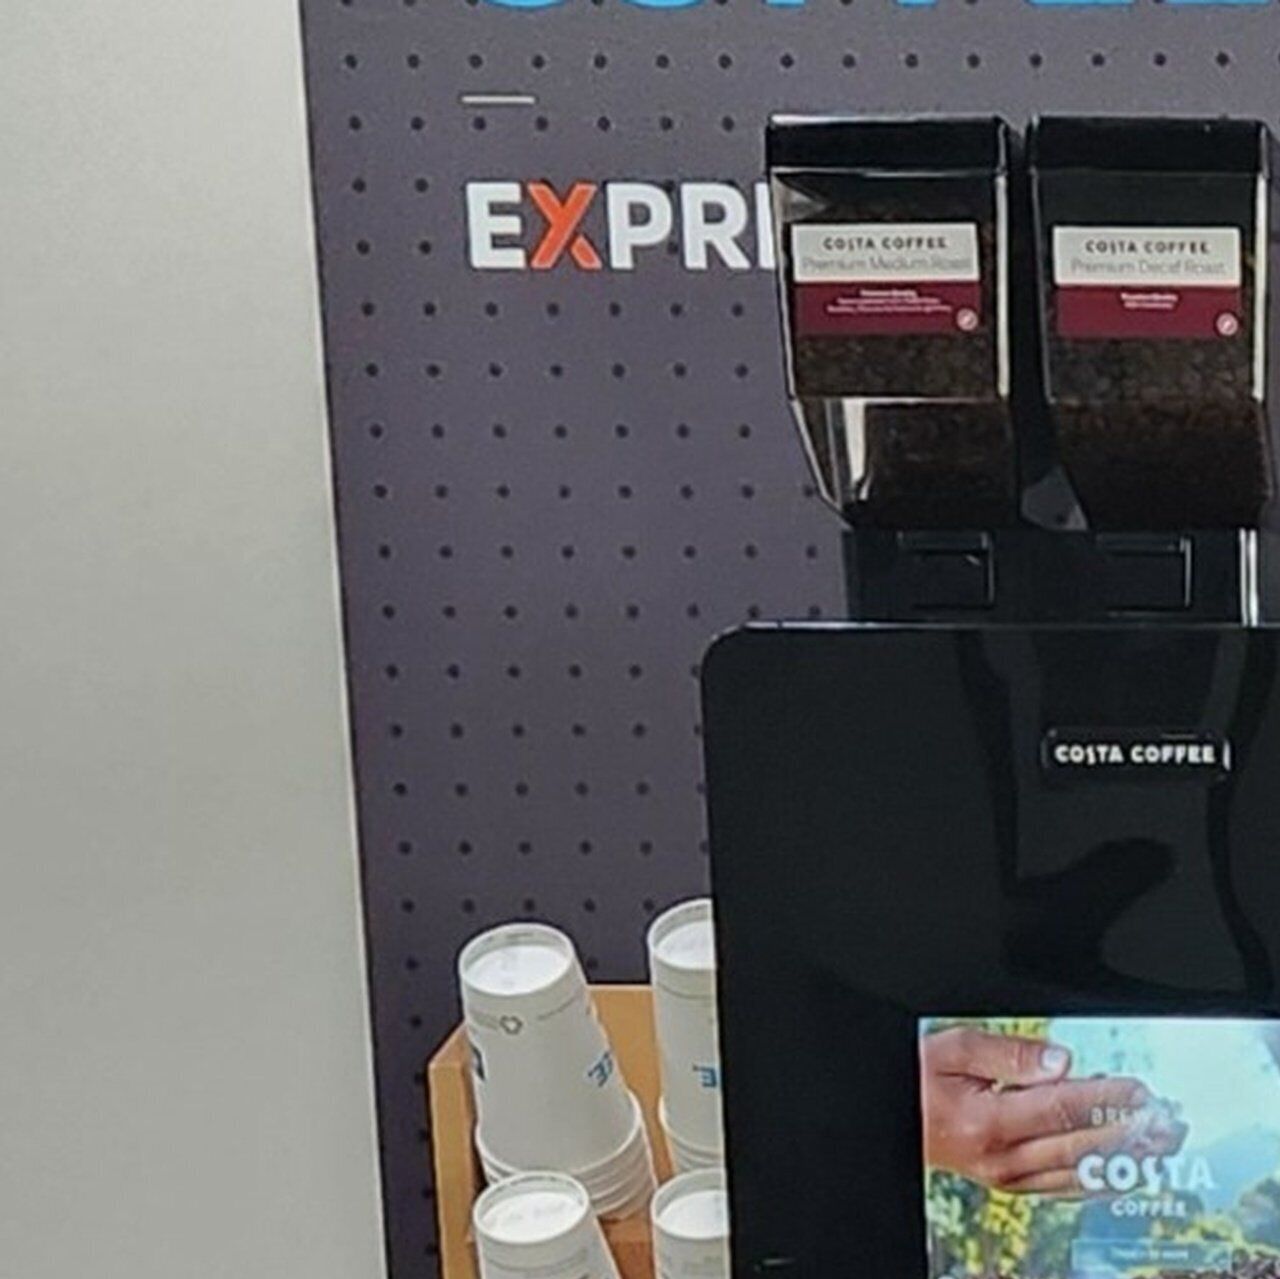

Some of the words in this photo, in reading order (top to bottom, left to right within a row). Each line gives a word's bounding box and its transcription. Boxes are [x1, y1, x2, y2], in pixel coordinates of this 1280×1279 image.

[823, 236, 875, 250] COSTA
[882, 236, 947, 249] COFFEE
[1085, 240, 1136, 254] COSTA
[1143, 240, 1209, 254] COFFEE
[1070, 258, 1135, 273] Premium
[1138, 258, 1181, 273] Decaf
[1054, 743, 1125, 766] COSTA
[1130, 744, 1216, 764] COFFEE
[1077, 1153, 1216, 1195] COSTA
[1111, 1199, 1187, 1217] COFFEE
